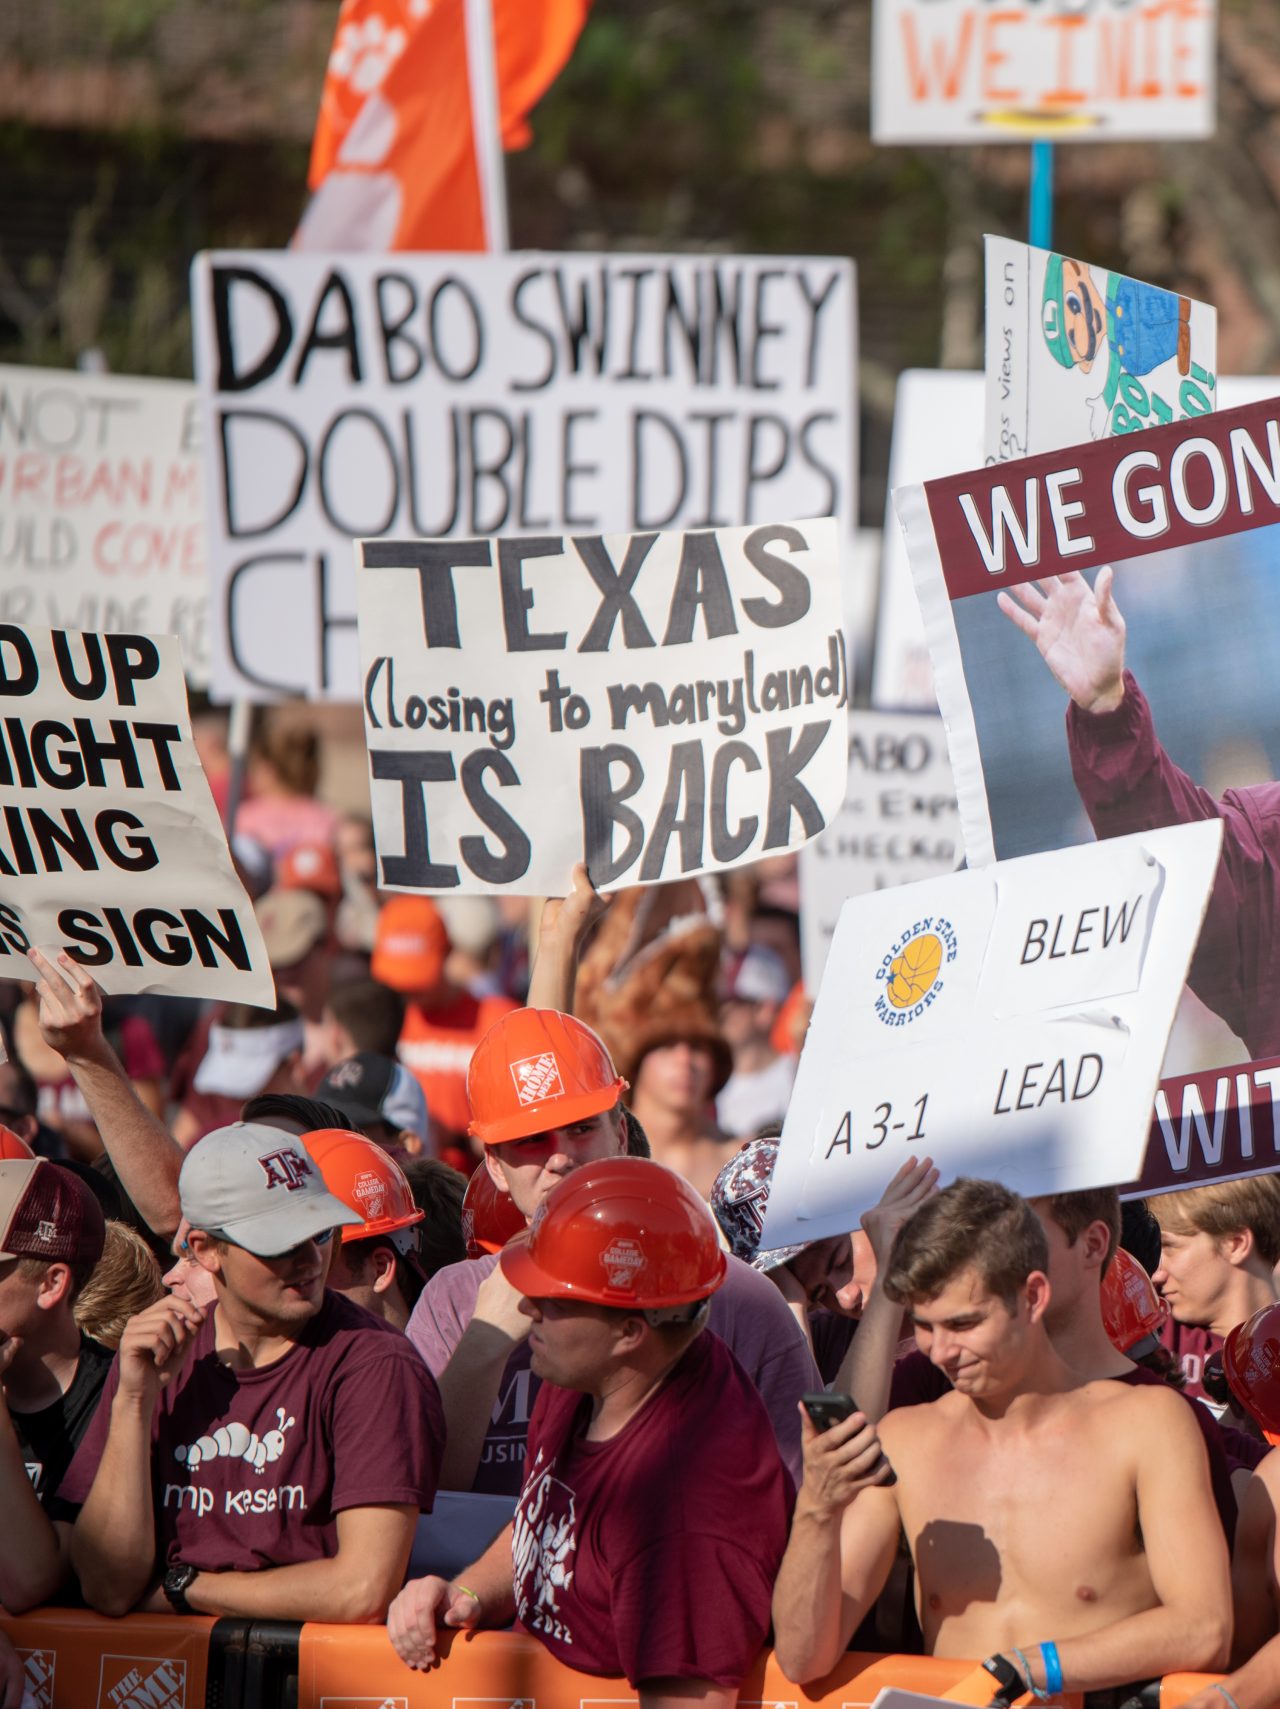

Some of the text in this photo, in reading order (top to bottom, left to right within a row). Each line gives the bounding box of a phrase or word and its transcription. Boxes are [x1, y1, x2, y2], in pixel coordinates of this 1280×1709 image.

[1003, 261, 1016, 306] on
[211, 264, 841, 393] DABO SWINNEY
[998, 326, 1014, 401] views
[0, 455, 153, 509] RBAN
[219, 404, 842, 541] DOUBLE DIPS
[958, 465, 1096, 575] WE
[361, 524, 812, 653] TEXAS
[51, 629, 161, 706] UP
[364, 628, 849, 750] (losing to maryland)
[0, 717, 182, 792] IGHT
[368, 719, 833, 890] IS BACK
[0, 805, 160, 877] ING
[57, 907, 253, 972] SIGN
[934, 917, 958, 963] STATE
[1019, 894, 1143, 966] BLEW
[874, 979, 944, 1027] WARRIORS
[520, 1053, 555, 1103] HOME
[993, 1052, 1104, 1115] LEAD
[825, 1092, 930, 1160] A 3-1
[356, 1184, 385, 1198] GAMEDAY
[603, 1253, 644, 1267] GAMEDAY
[531, 1610, 573, 1645] 2022
[107, 1667, 143, 1705] THE
